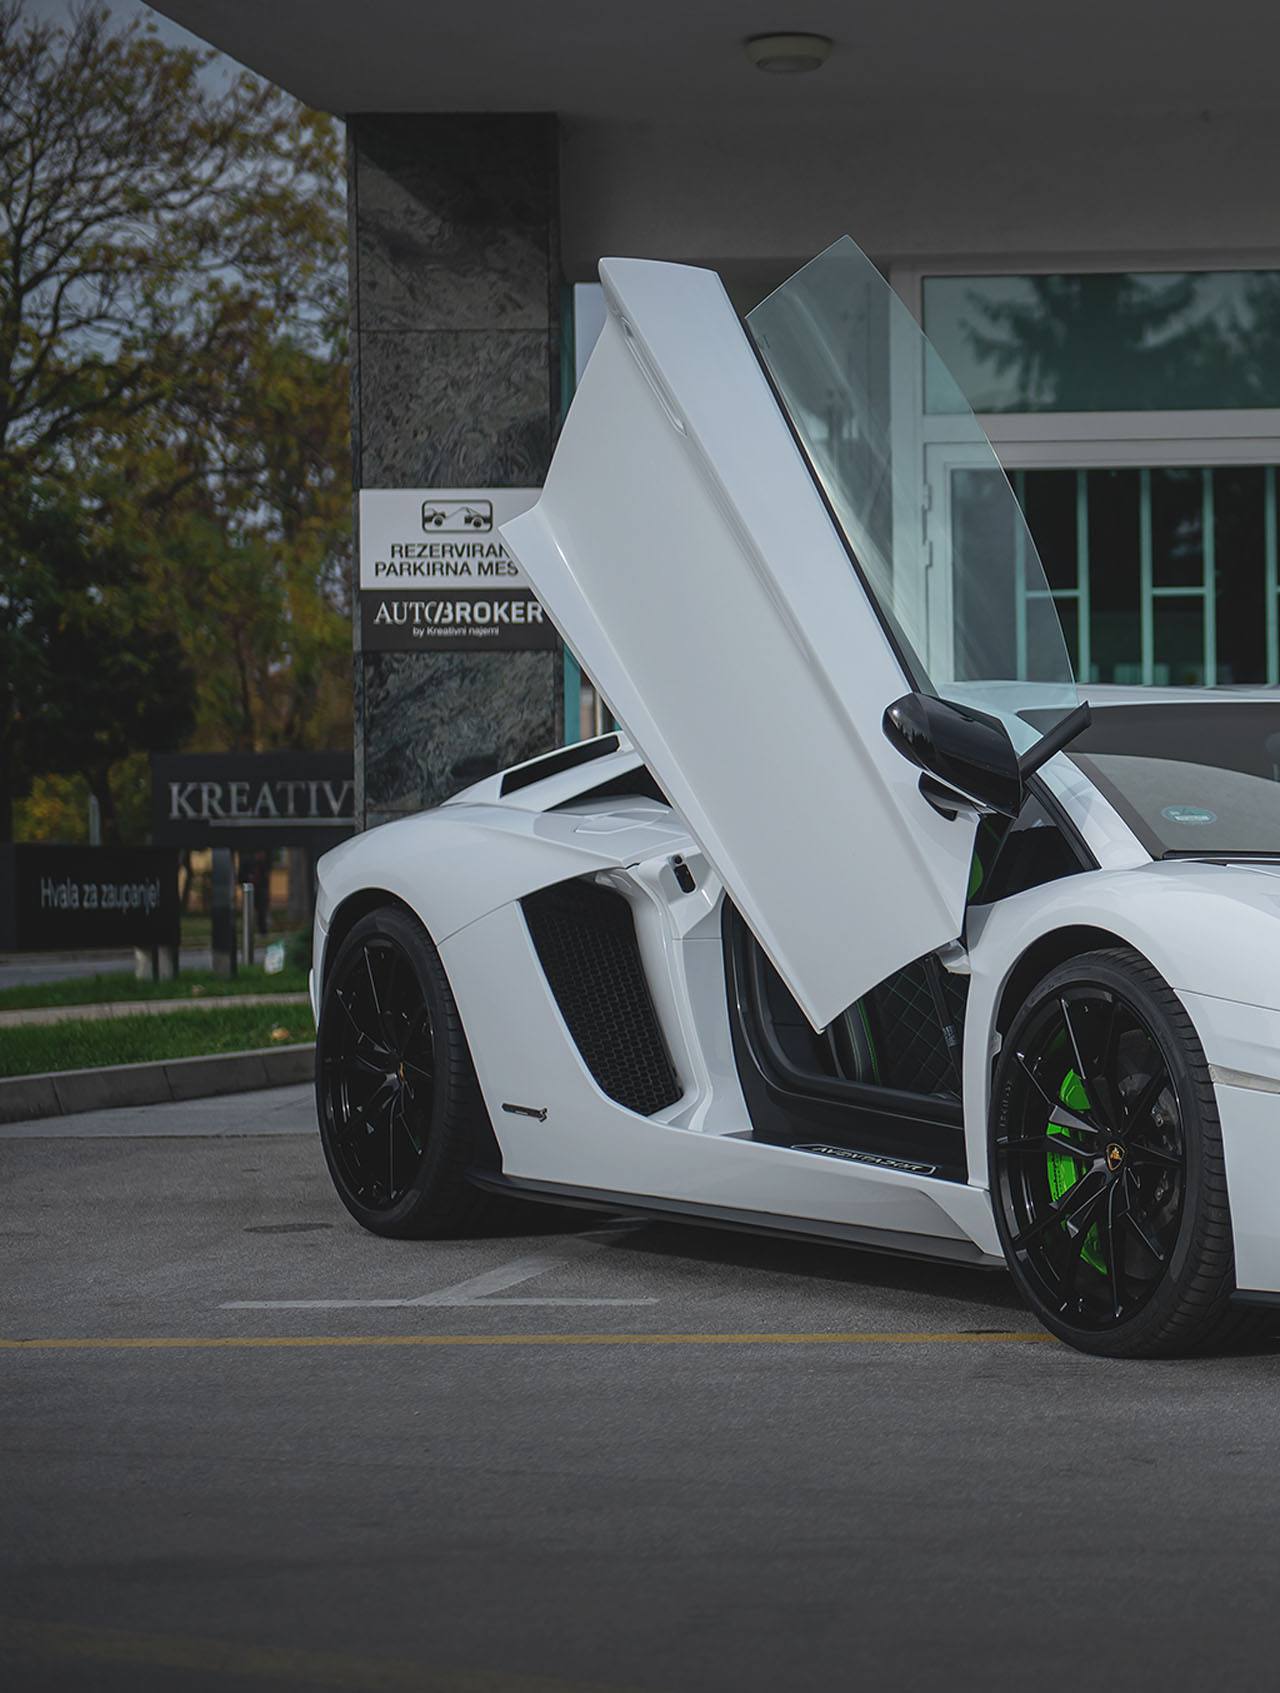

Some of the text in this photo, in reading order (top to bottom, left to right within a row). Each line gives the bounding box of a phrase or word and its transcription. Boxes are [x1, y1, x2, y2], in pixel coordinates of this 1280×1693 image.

[374, 561, 472, 577] PARKIRNA
[413, 626, 500, 638] by Kreativni najemi
[40, 876, 160, 916] Hvala za zaupanje!
